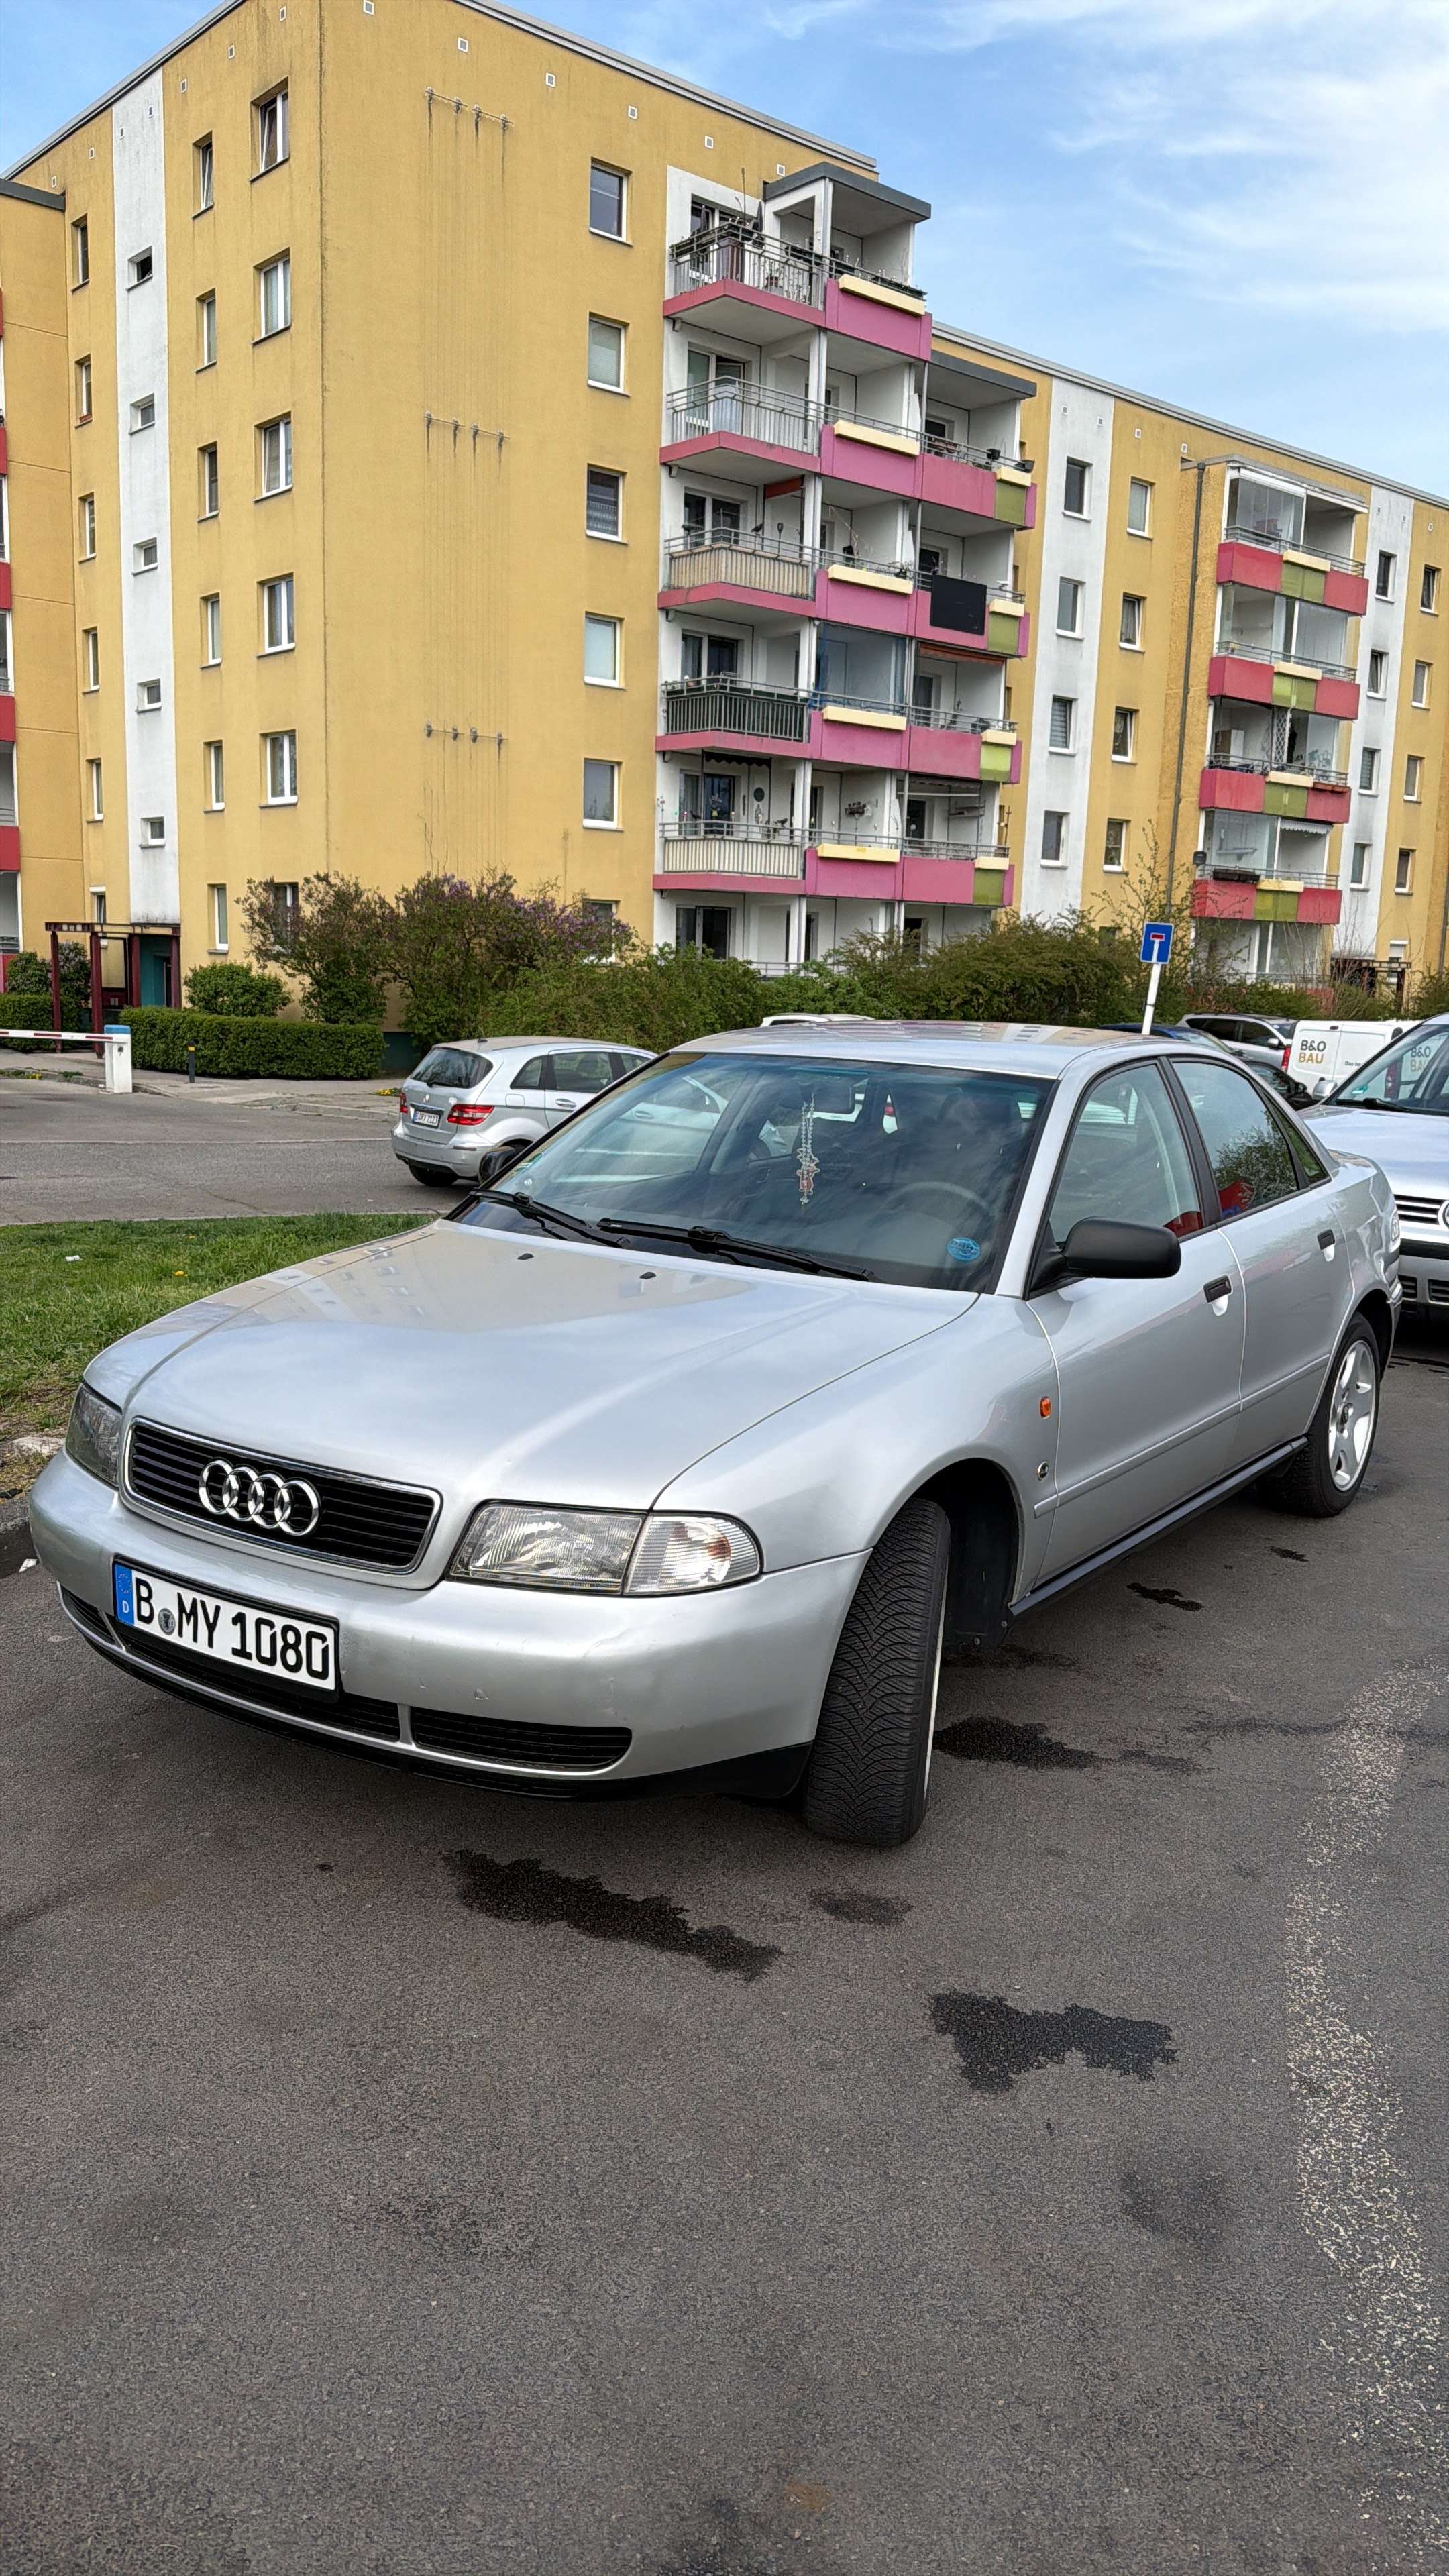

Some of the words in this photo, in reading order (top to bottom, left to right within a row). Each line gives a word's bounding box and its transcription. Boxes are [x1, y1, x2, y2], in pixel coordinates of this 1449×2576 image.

[1301, 1040, 1326, 1052] B&O
[1411, 1046, 1432, 1058] B&O
[1299, 1052, 1324, 1064] BAU
[122, 1600, 129, 1613] D
[135, 1577, 153, 1624] B
[177, 1592, 221, 1648] MY
[231, 1611, 329, 1680] 1080
